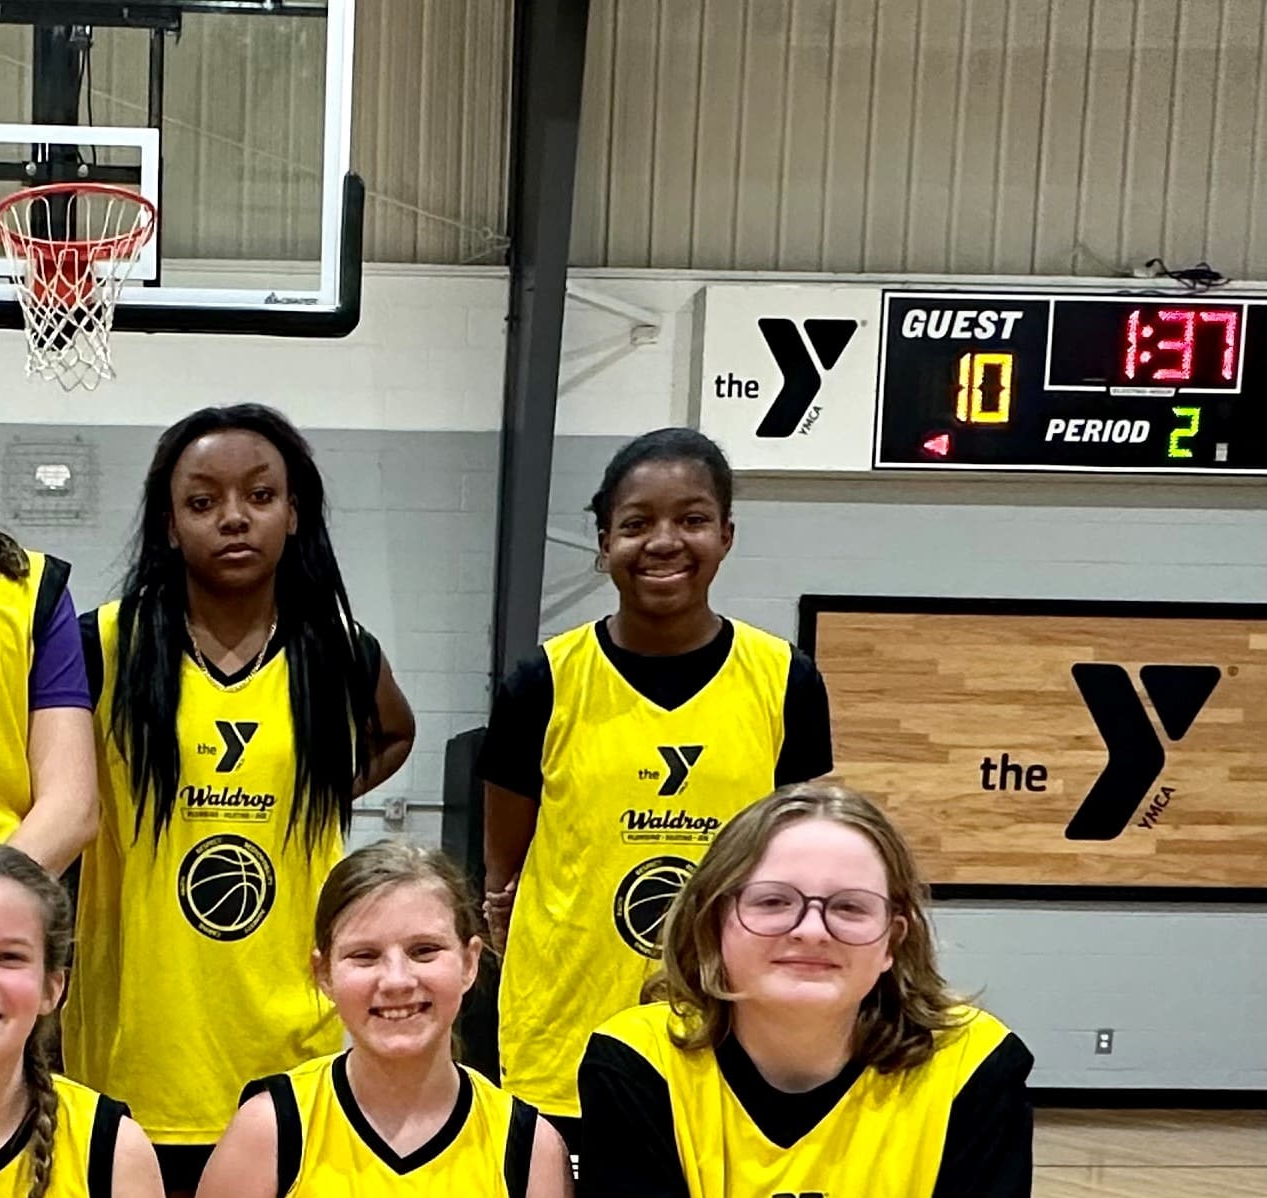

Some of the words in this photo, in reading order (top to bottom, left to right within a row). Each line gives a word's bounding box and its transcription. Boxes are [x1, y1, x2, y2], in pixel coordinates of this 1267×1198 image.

[902, 310, 1023, 339] GUEST
[1125, 309, 1237, 380] 1:37
[715, 374, 759, 399] the
[956, 352, 1014, 423] 10
[797, 405, 824, 436] YMCA
[1045, 419, 1150, 444] PERIOD
[1169, 407, 1200, 458] 2
[197, 744, 216, 755] the
[638, 769, 660, 780] the
[980, 754, 1048, 792] the
[180, 785, 276, 811] Waldrop
[1137, 785, 1176, 830] YMCA
[620, 809, 722, 834] Waldrop
